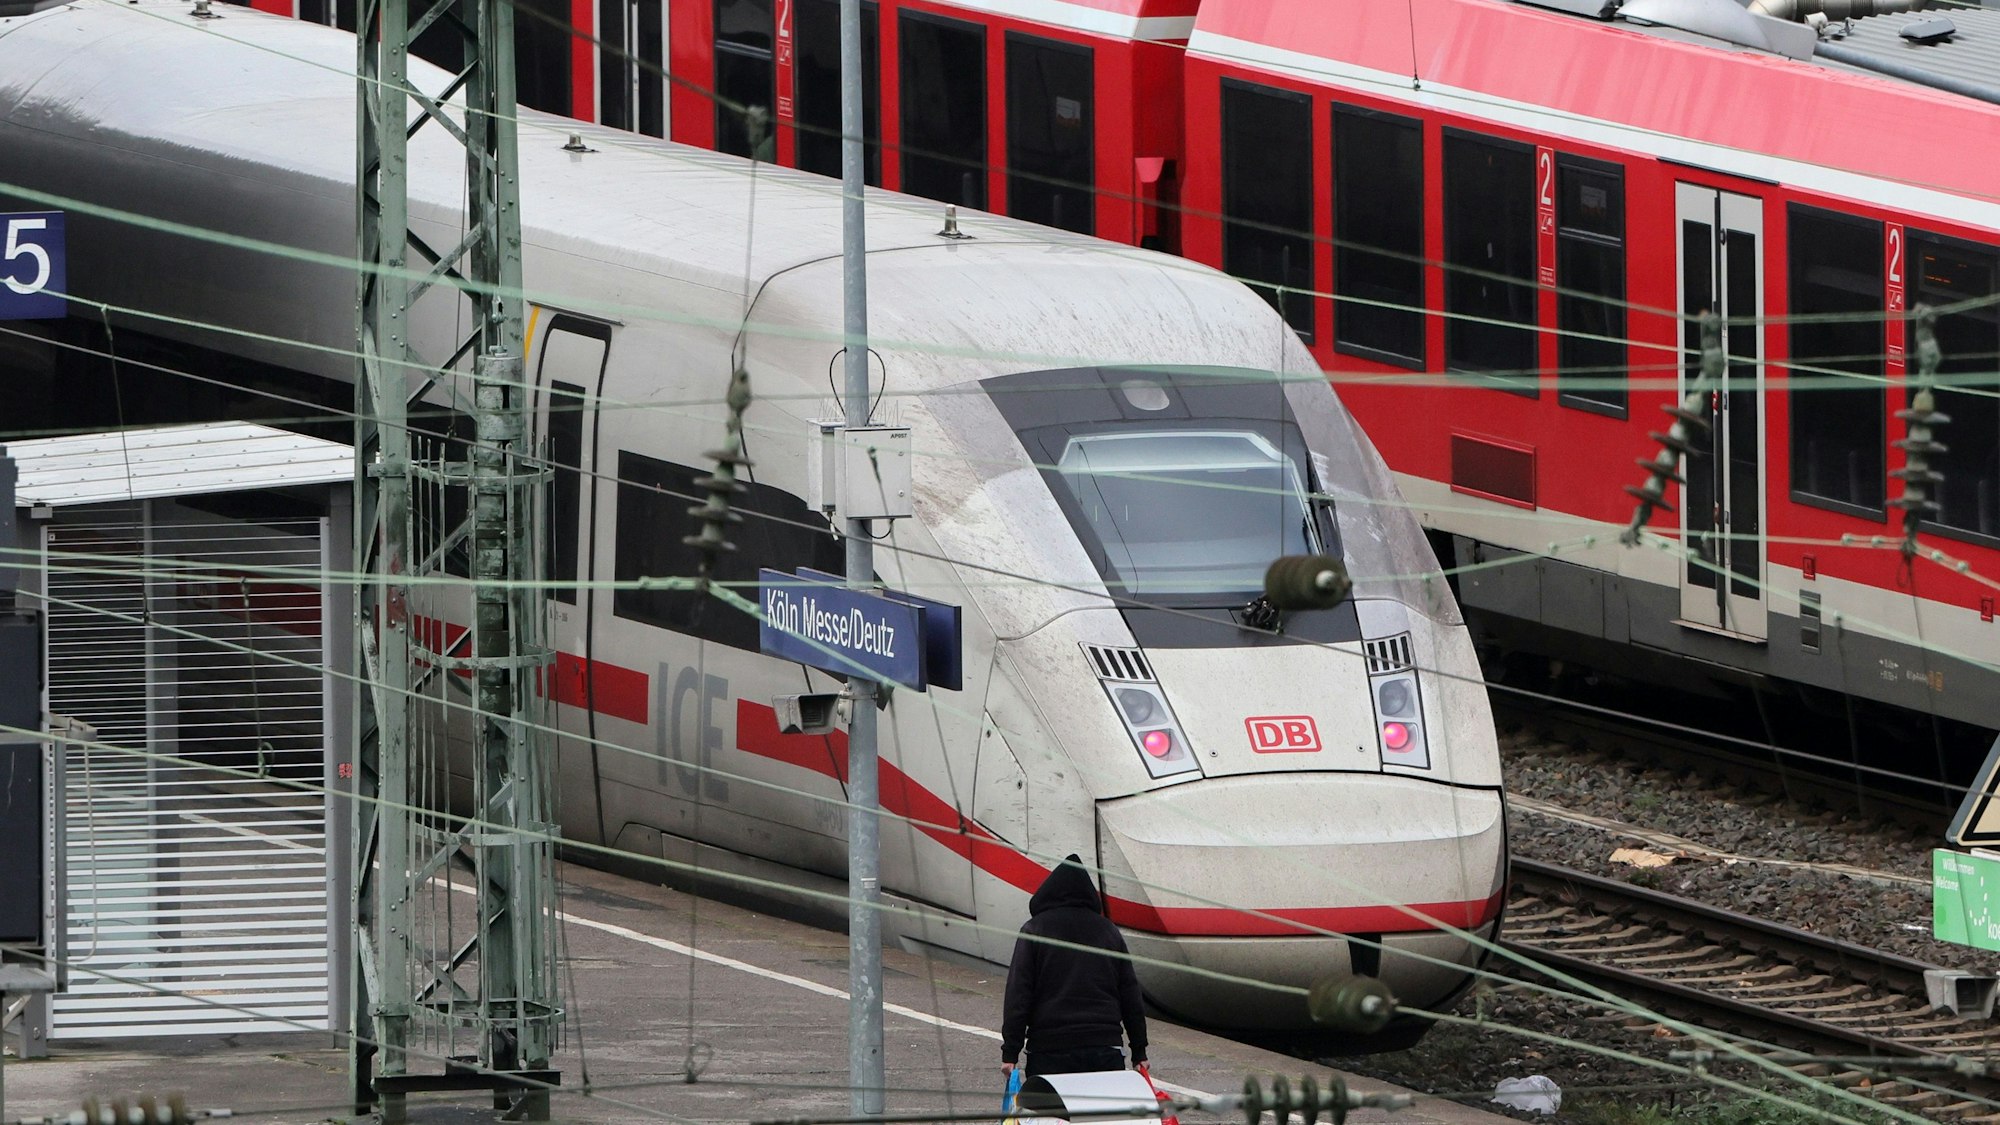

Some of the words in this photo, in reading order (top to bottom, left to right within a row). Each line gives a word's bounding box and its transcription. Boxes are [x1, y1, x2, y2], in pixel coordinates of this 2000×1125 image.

[779, 0, 789, 37] 2
[1540, 152, 1552, 206] 2
[5, 218, 51, 295] 5
[1889, 228, 1900, 283] 2
[767, 588, 798, 634] Köln
[803, 596, 895, 658] Messe/Deutz
[656, 661, 729, 802] ICE
[1255, 721, 1312, 748] DB
[1935, 875, 1959, 891] Welcome
